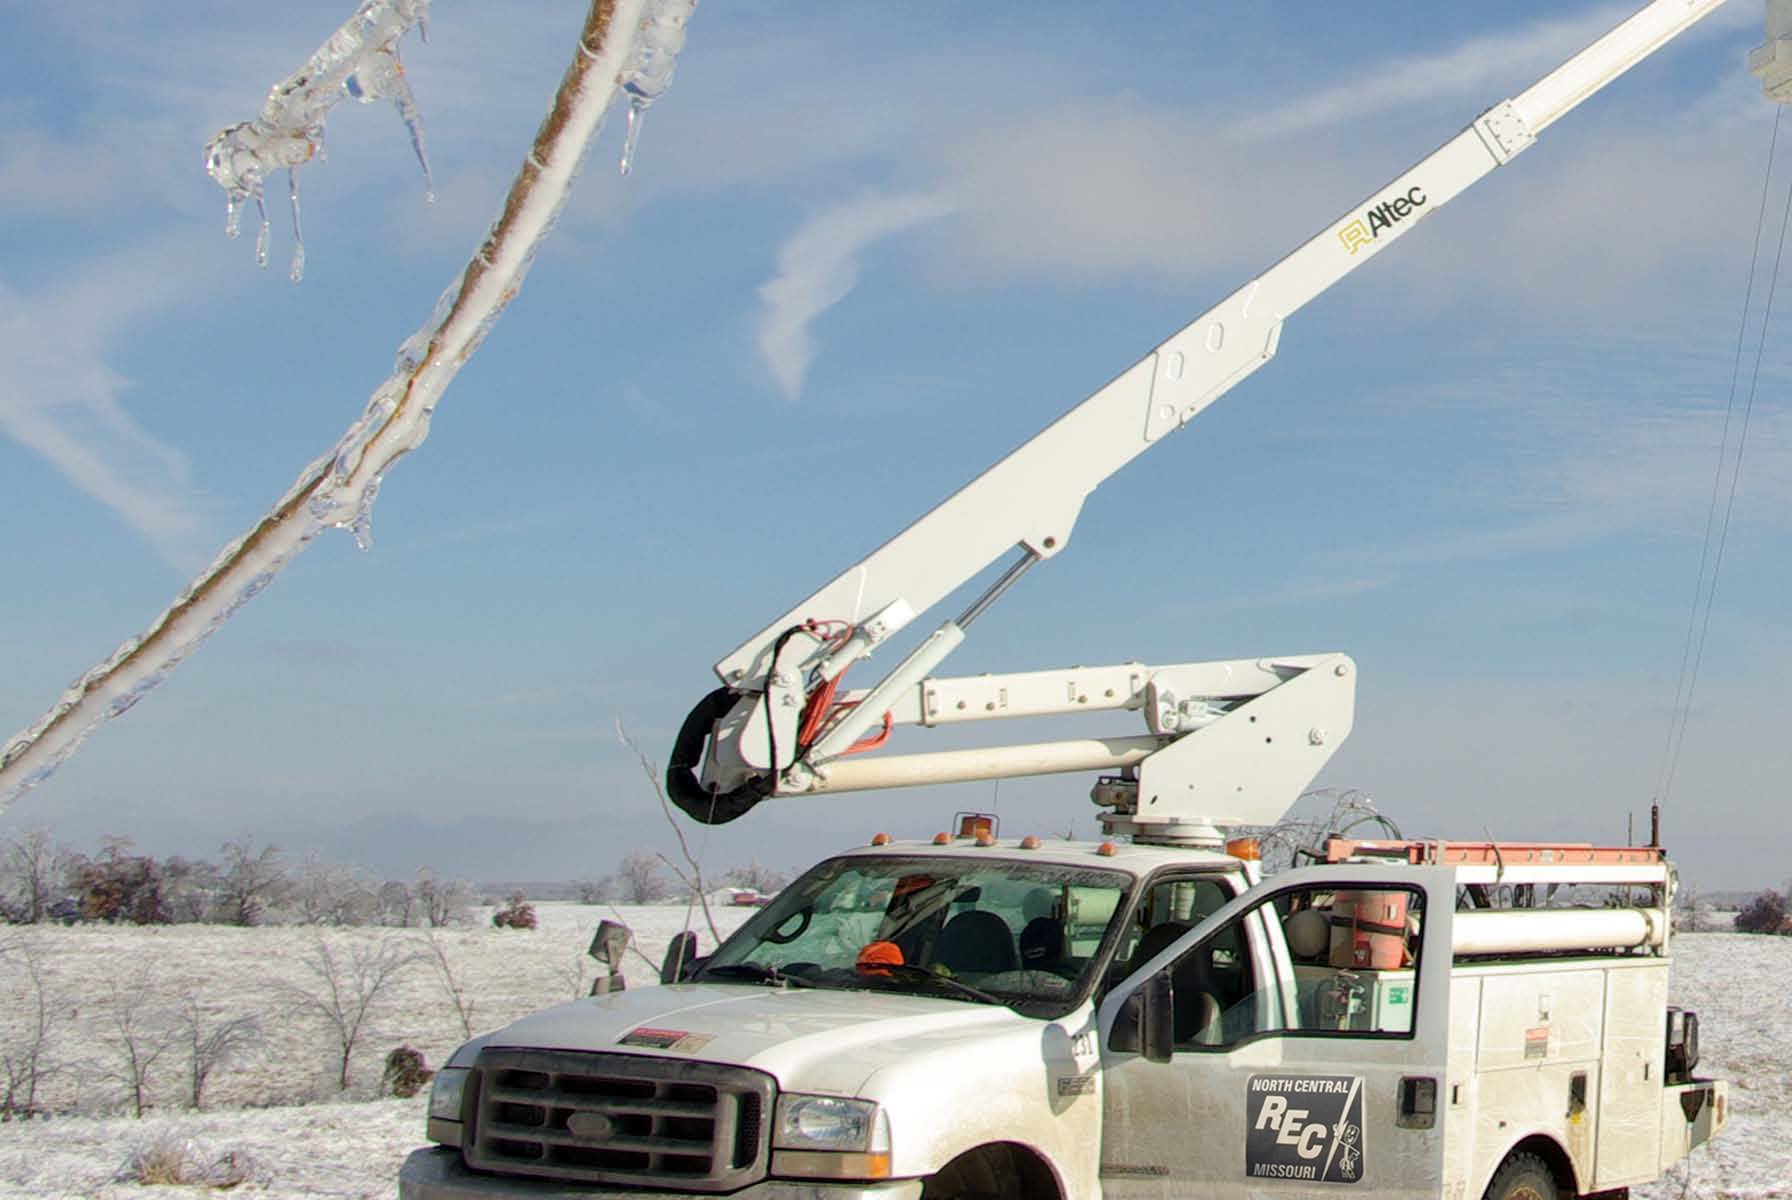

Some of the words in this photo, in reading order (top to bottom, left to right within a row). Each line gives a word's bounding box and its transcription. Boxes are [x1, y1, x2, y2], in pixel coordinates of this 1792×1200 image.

[1368, 186, 1426, 238] Altec
[1252, 1079, 1292, 1092] NORTH
[1294, 1080, 1349, 1093] CENTRAL
[1255, 1095, 1327, 1159] REC
[1253, 1163, 1316, 1179] MISSOURI
